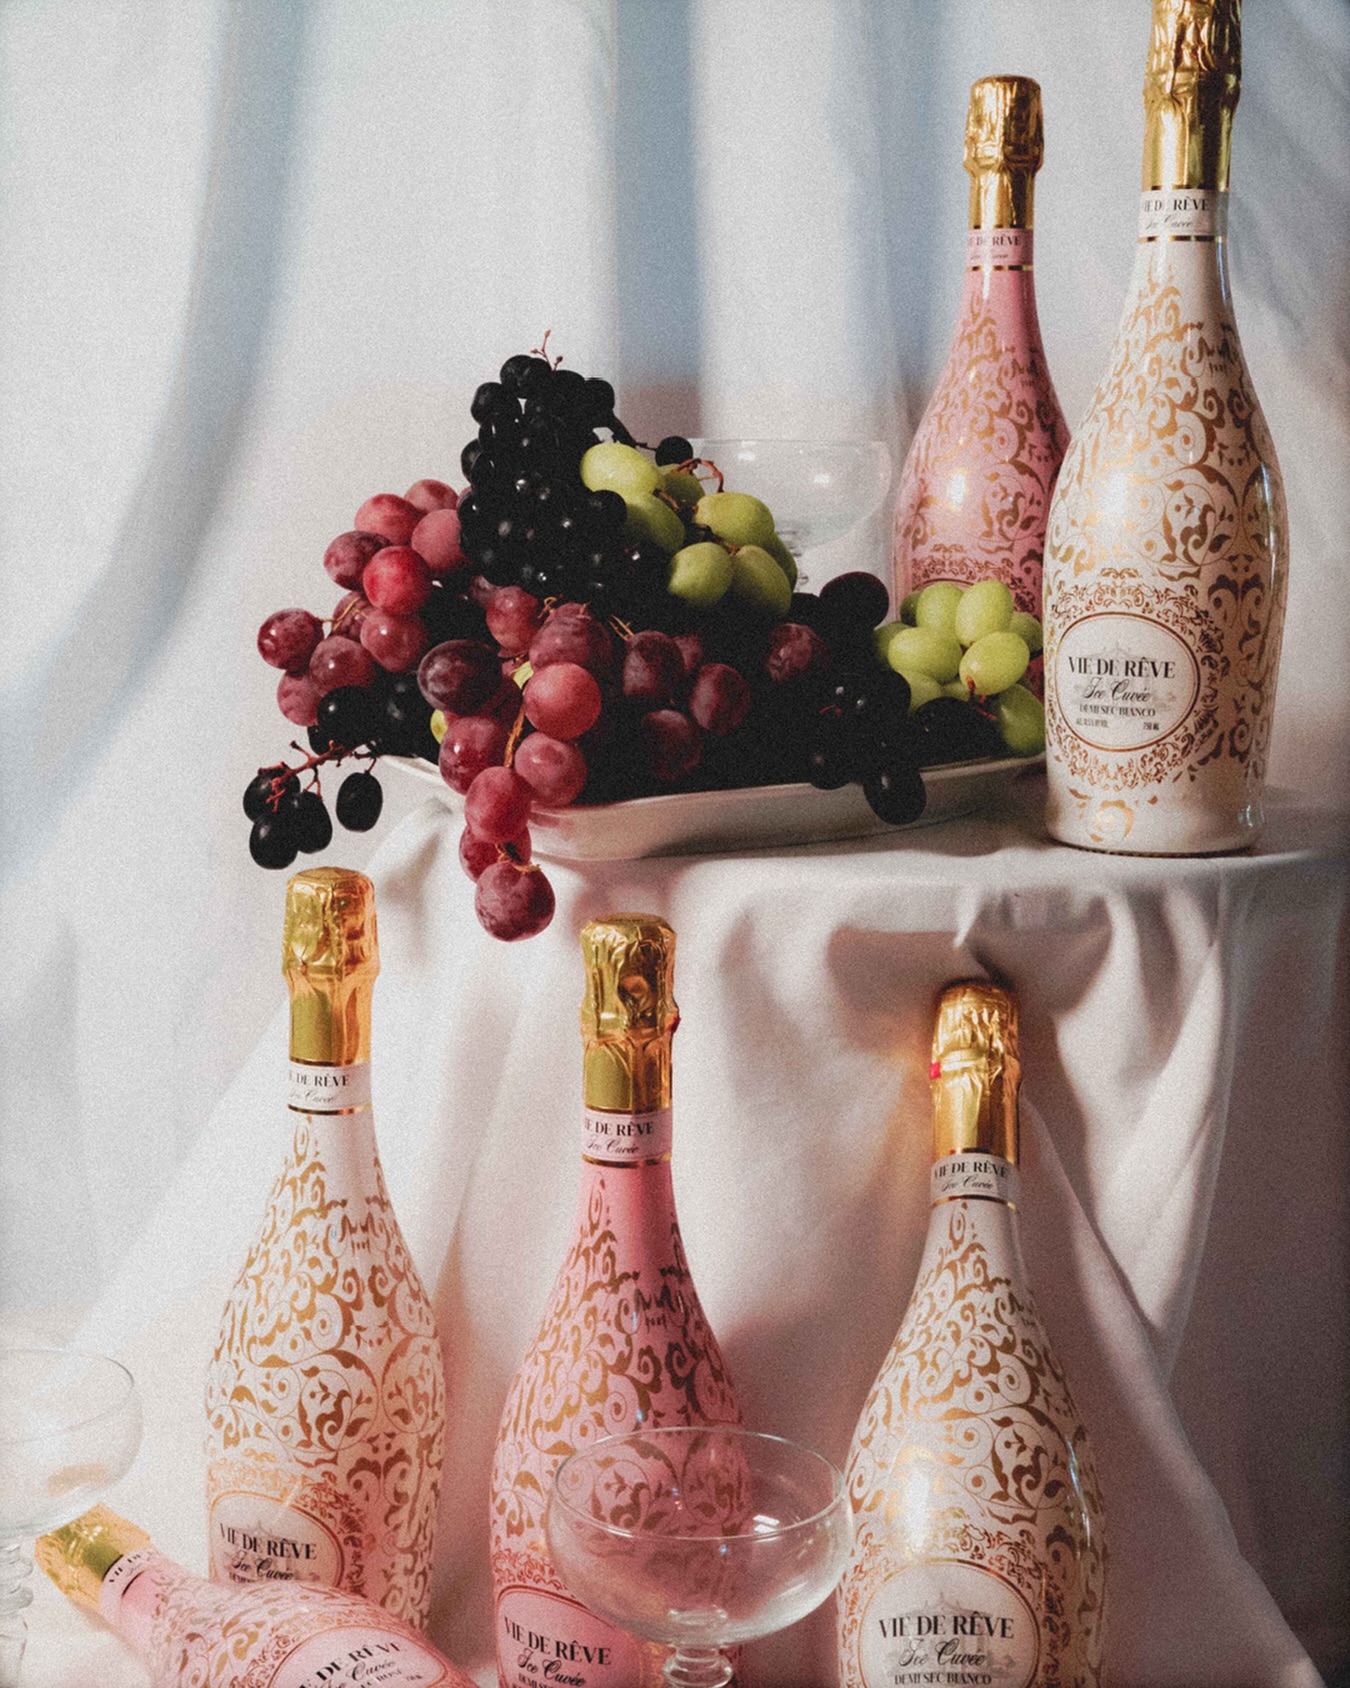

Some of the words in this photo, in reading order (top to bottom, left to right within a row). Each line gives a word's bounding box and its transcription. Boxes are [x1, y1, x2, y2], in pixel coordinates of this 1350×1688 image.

[1173, 195, 1210, 212] RÊVE
[1067, 656, 1093, 675] VIE
[1096, 658, 1120, 677] DE
[1124, 656, 1177, 680] RÊVE
[1109, 678, 1152, 703] Cuvée
[1100, 704, 1117, 716] SEC
[1118, 705, 1157, 718] BIANCO
[314, 1072, 349, 1087] RÊVE
[594, 1120, 612, 1135] DE
[616, 1120, 655, 1137] RÊVE
[951, 1161, 970, 1174] DE
[972, 1159, 1009, 1178] RÊVE
[219, 1521, 240, 1546] VIE
[242, 1533, 264, 1554] DE
[266, 1538, 318, 1561] RÊVE
[254, 1557, 295, 1582] Cuvée
[878, 1616, 911, 1639] VIE
[916, 1614, 947, 1636] DE
[952, 1610, 1015, 1639] RÊVE
[503, 1615, 526, 1645] VIE
[528, 1630, 552, 1655] DE
[555, 1639, 612, 1666] RÊVE
[898, 1637, 930, 1667] Ice
[934, 1636, 987, 1666] Cuvée
[315, 1656, 349, 1682] DE
[347, 1642, 408, 1663] RÊVE
[541, 1658, 586, 1688] Cuvée
[894, 1672, 922, 1686] DEMI
[922, 1671, 945, 1684] SEC
[946, 1671, 993, 1686] BIANCO
